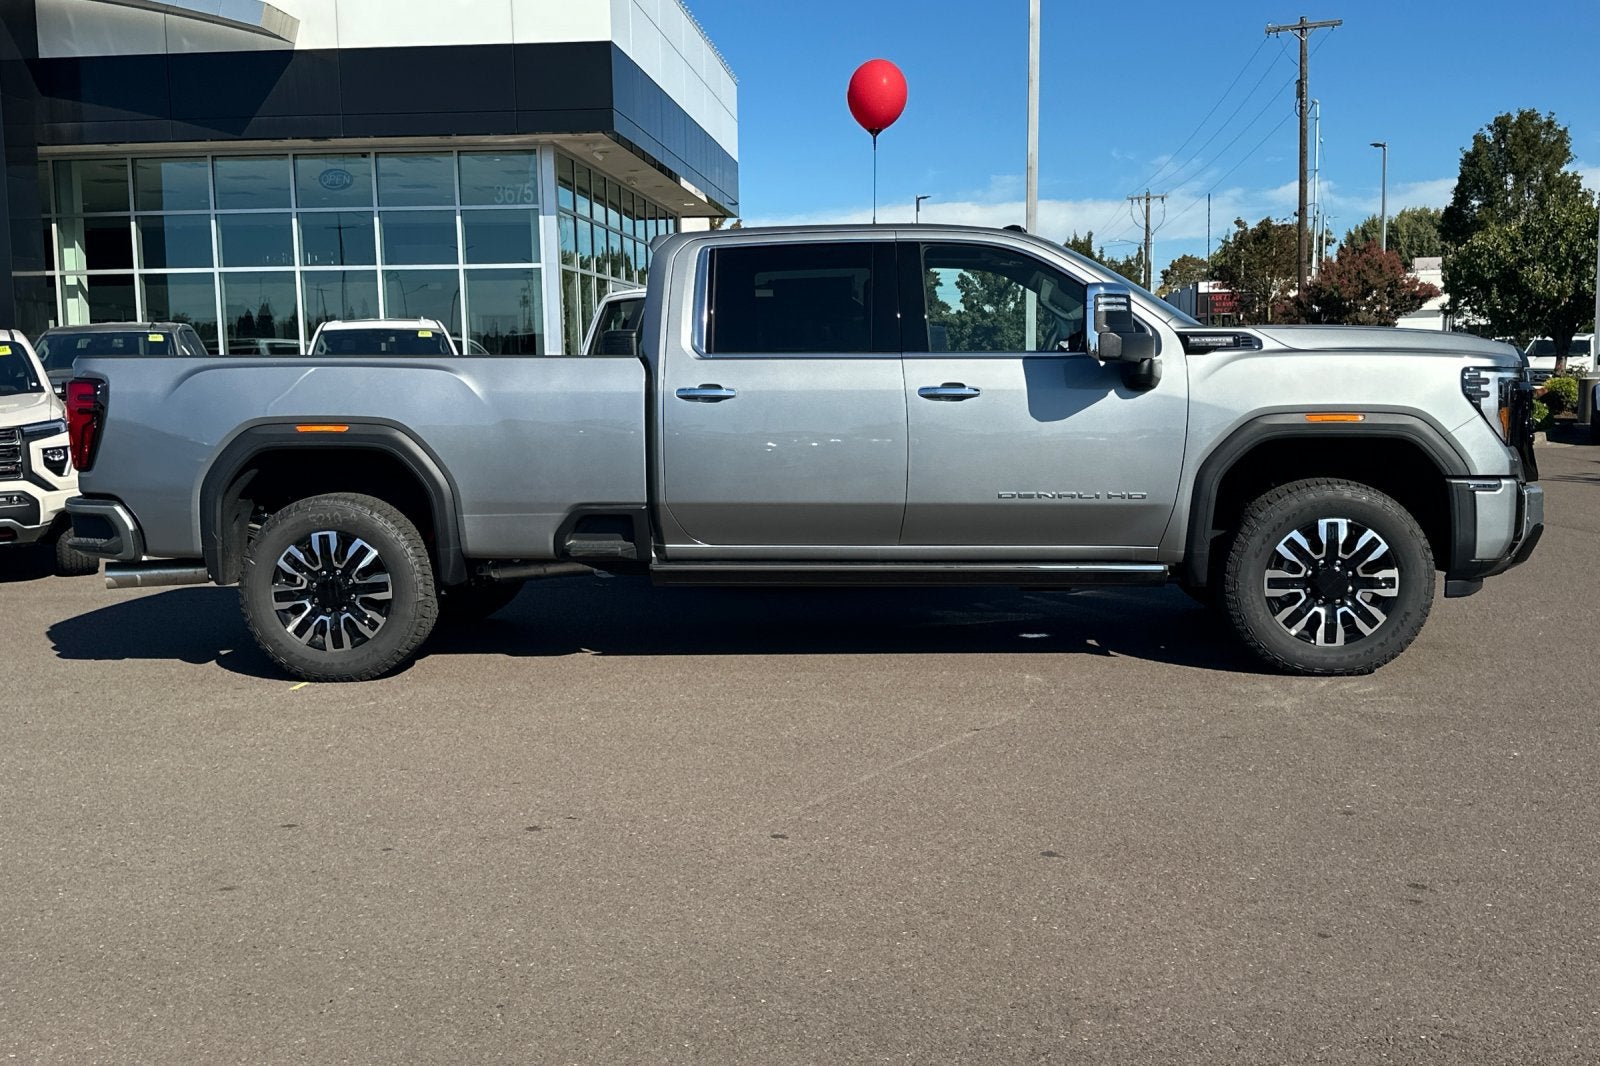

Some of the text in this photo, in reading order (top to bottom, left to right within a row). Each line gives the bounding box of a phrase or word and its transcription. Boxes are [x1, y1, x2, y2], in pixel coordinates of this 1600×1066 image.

[321, 174, 351, 185] OPEN
[494, 183, 534, 204] 3675
[997, 490, 1149, 500] DENALI HD
